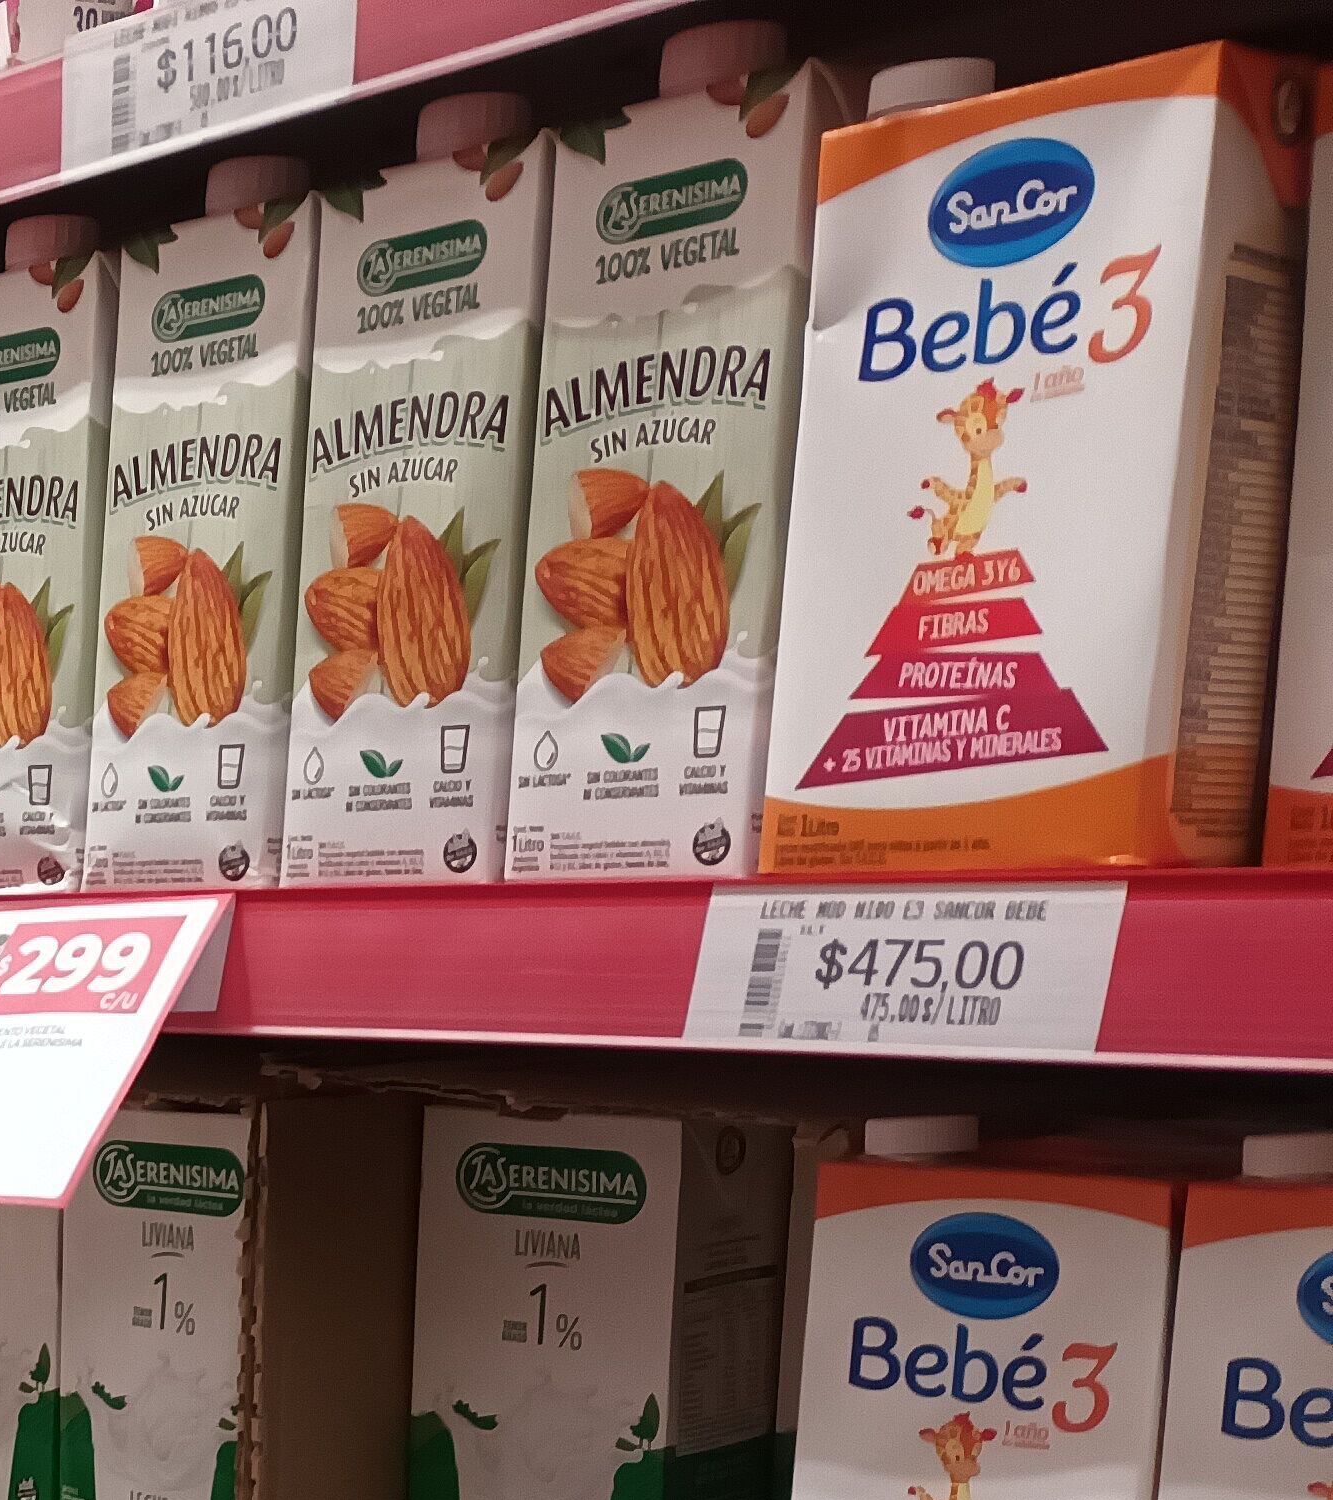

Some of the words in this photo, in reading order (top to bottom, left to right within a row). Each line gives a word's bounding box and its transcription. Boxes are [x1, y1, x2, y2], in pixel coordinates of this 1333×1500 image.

[157, 7, 297, 94] $116,00
[947, 180, 1077, 235] SanCor
[595, 252, 650, 284] 100%
[660, 229, 739, 270] VEGETAL
[357, 306, 403, 333] 100%
[412, 284, 479, 321] VEGETAL
[858, 264, 1082, 383] Bebé
[1088, 245, 1161, 364] 3
[150, 350, 192, 377] 100%
[198, 335, 258, 366] VEGETAL
[3, 382, 57, 407] VEGETAL
[544, 346, 771, 440] ALMENDRA
[310, 391, 510, 473] ALMENDRA
[589, 428, 628, 463] SIN
[636, 412, 716, 452] AZÚCAR
[111, 434, 283, 508] ALMENDRA
[349, 470, 381, 497] SIN
[387, 452, 458, 485] AZÚCAR
[145, 505, 174, 532] SIN
[180, 493, 240, 522] AZÚCAR
[913, 567, 975, 594] OMEGA
[918, 610, 989, 640] FIBRAS
[898, 656, 1018, 690] PROTEÍNAS
[883, 708, 987, 742] VITAMINA
[995, 706, 1010, 731] C
[865, 741, 952, 769] VITAMINAS
[955, 739, 967, 760] Y
[970, 727, 1061, 759] MINERALES
[815, 939, 1025, 993] $475,00
[142, 1221, 194, 1252] LIVIANA
[515, 1229, 580, 1261] LIVIANA
[929, 1243, 1044, 1287] SanCor
[847, 1316, 1047, 1410] Bebé
[1051, 1342, 1118, 1432] 3
